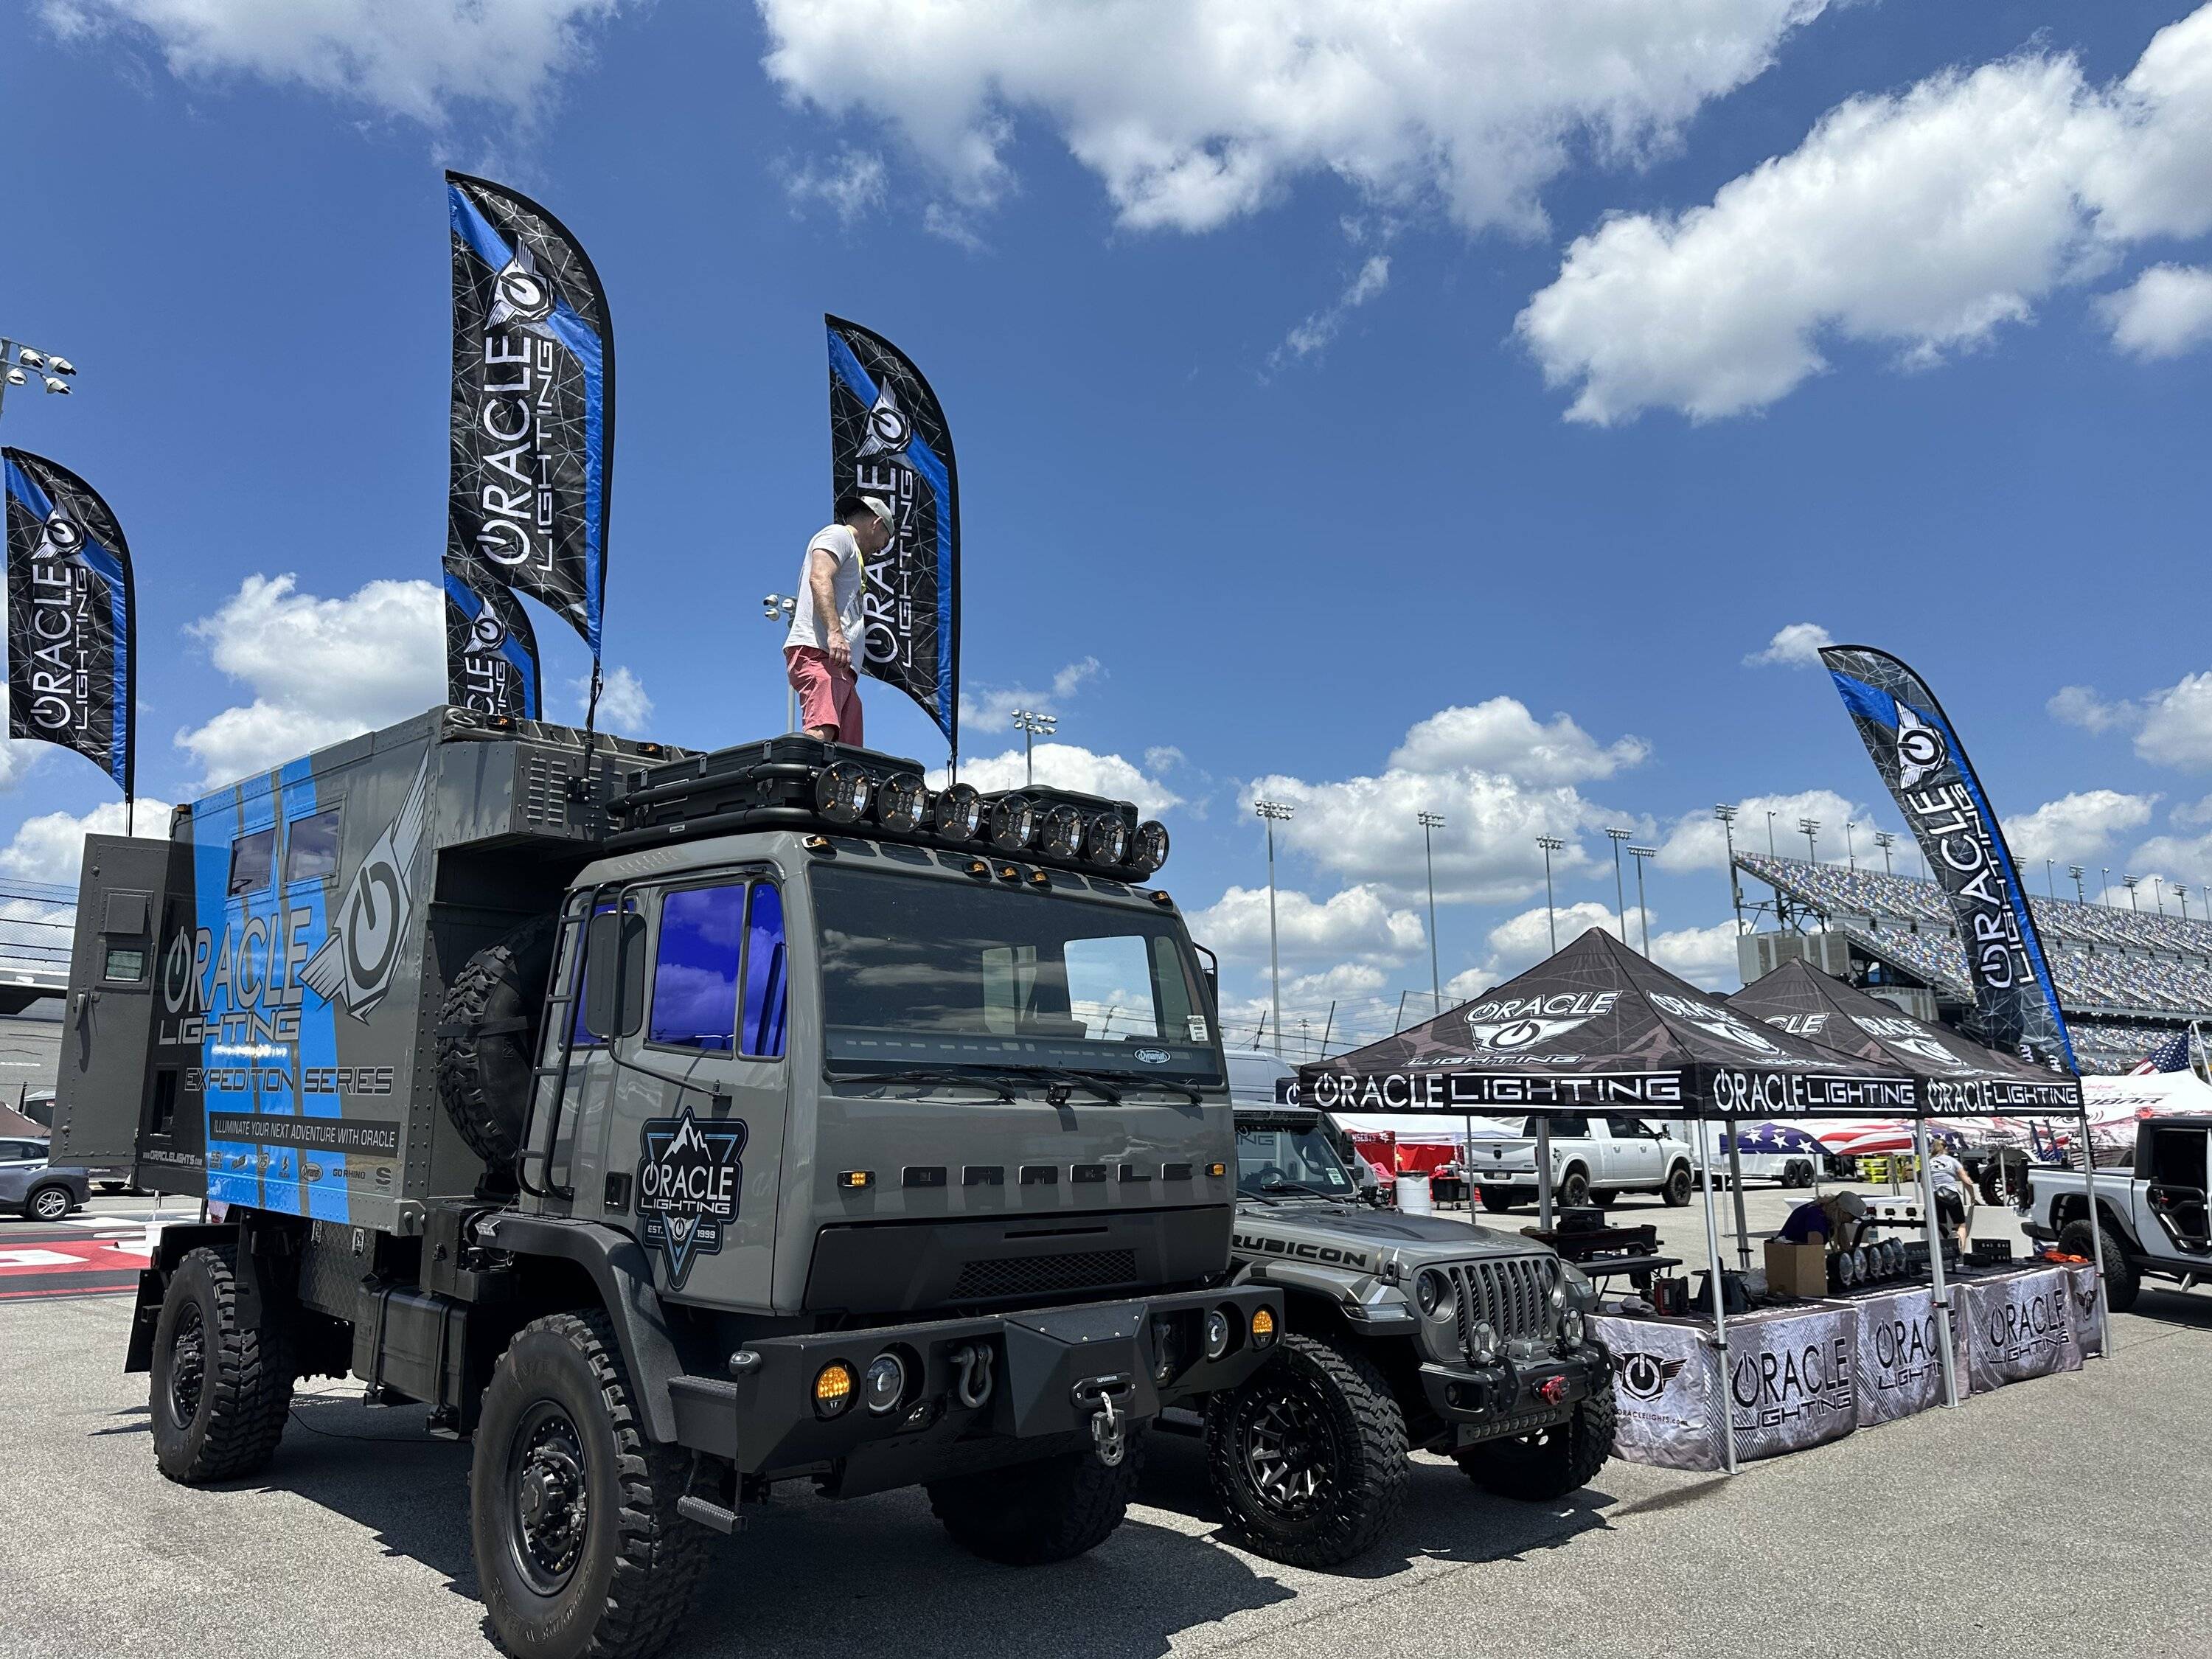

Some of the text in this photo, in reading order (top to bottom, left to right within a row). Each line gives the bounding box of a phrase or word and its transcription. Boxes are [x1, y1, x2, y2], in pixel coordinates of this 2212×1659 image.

[476, 336, 532, 566] ORACLE
[537, 338, 554, 571] LIGHTING
[857, 464, 898, 664] ORAE
[899, 470, 914, 668] LIGHTING
[30, 564, 72, 730] ORACLE
[75, 566, 88, 731] LIGHTING
[465, 656, 495, 715] CLE
[1907, 783, 2012, 989] ORACLE
[164, 906, 313, 1014] ORACLE
[159, 1009, 302, 1046] LIGHTING
[1464, 990, 1624, 1023] ORACLE
[184, 1066, 394, 1096] EXPEDITION SERIES
[1402, 1054, 1586, 1067] LIGHTING
[1313, 1072, 1444, 1109] ORACLE
[1450, 1077, 1681, 1102] LIGHTING
[1714, 1068, 1916, 1113] ORACLE LIGHTING
[1927, 1077, 2079, 1113] ORACLE LIGHTING
[213, 1119, 395, 1148] ILLUMINATE YOUR NEXT ADVENTURE WITH ORACLE
[333, 1168, 366, 1180] GO RHINO
[642, 1161, 734, 1201] ORACLE
[641, 1197, 731, 1214] LIGHTING
[647, 1225, 716, 1239] EST. 1999
[1232, 1234, 1367, 1267] RUBICON
[1876, 1309, 1955, 1369] ORACE
[1989, 1288, 2063, 1348] ORACLE
[1986, 1332, 2069, 1365] LIGHTING
[1731, 1337, 1848, 1408] ORACLE
[1732, 1389, 1851, 1431] LIGHTING
